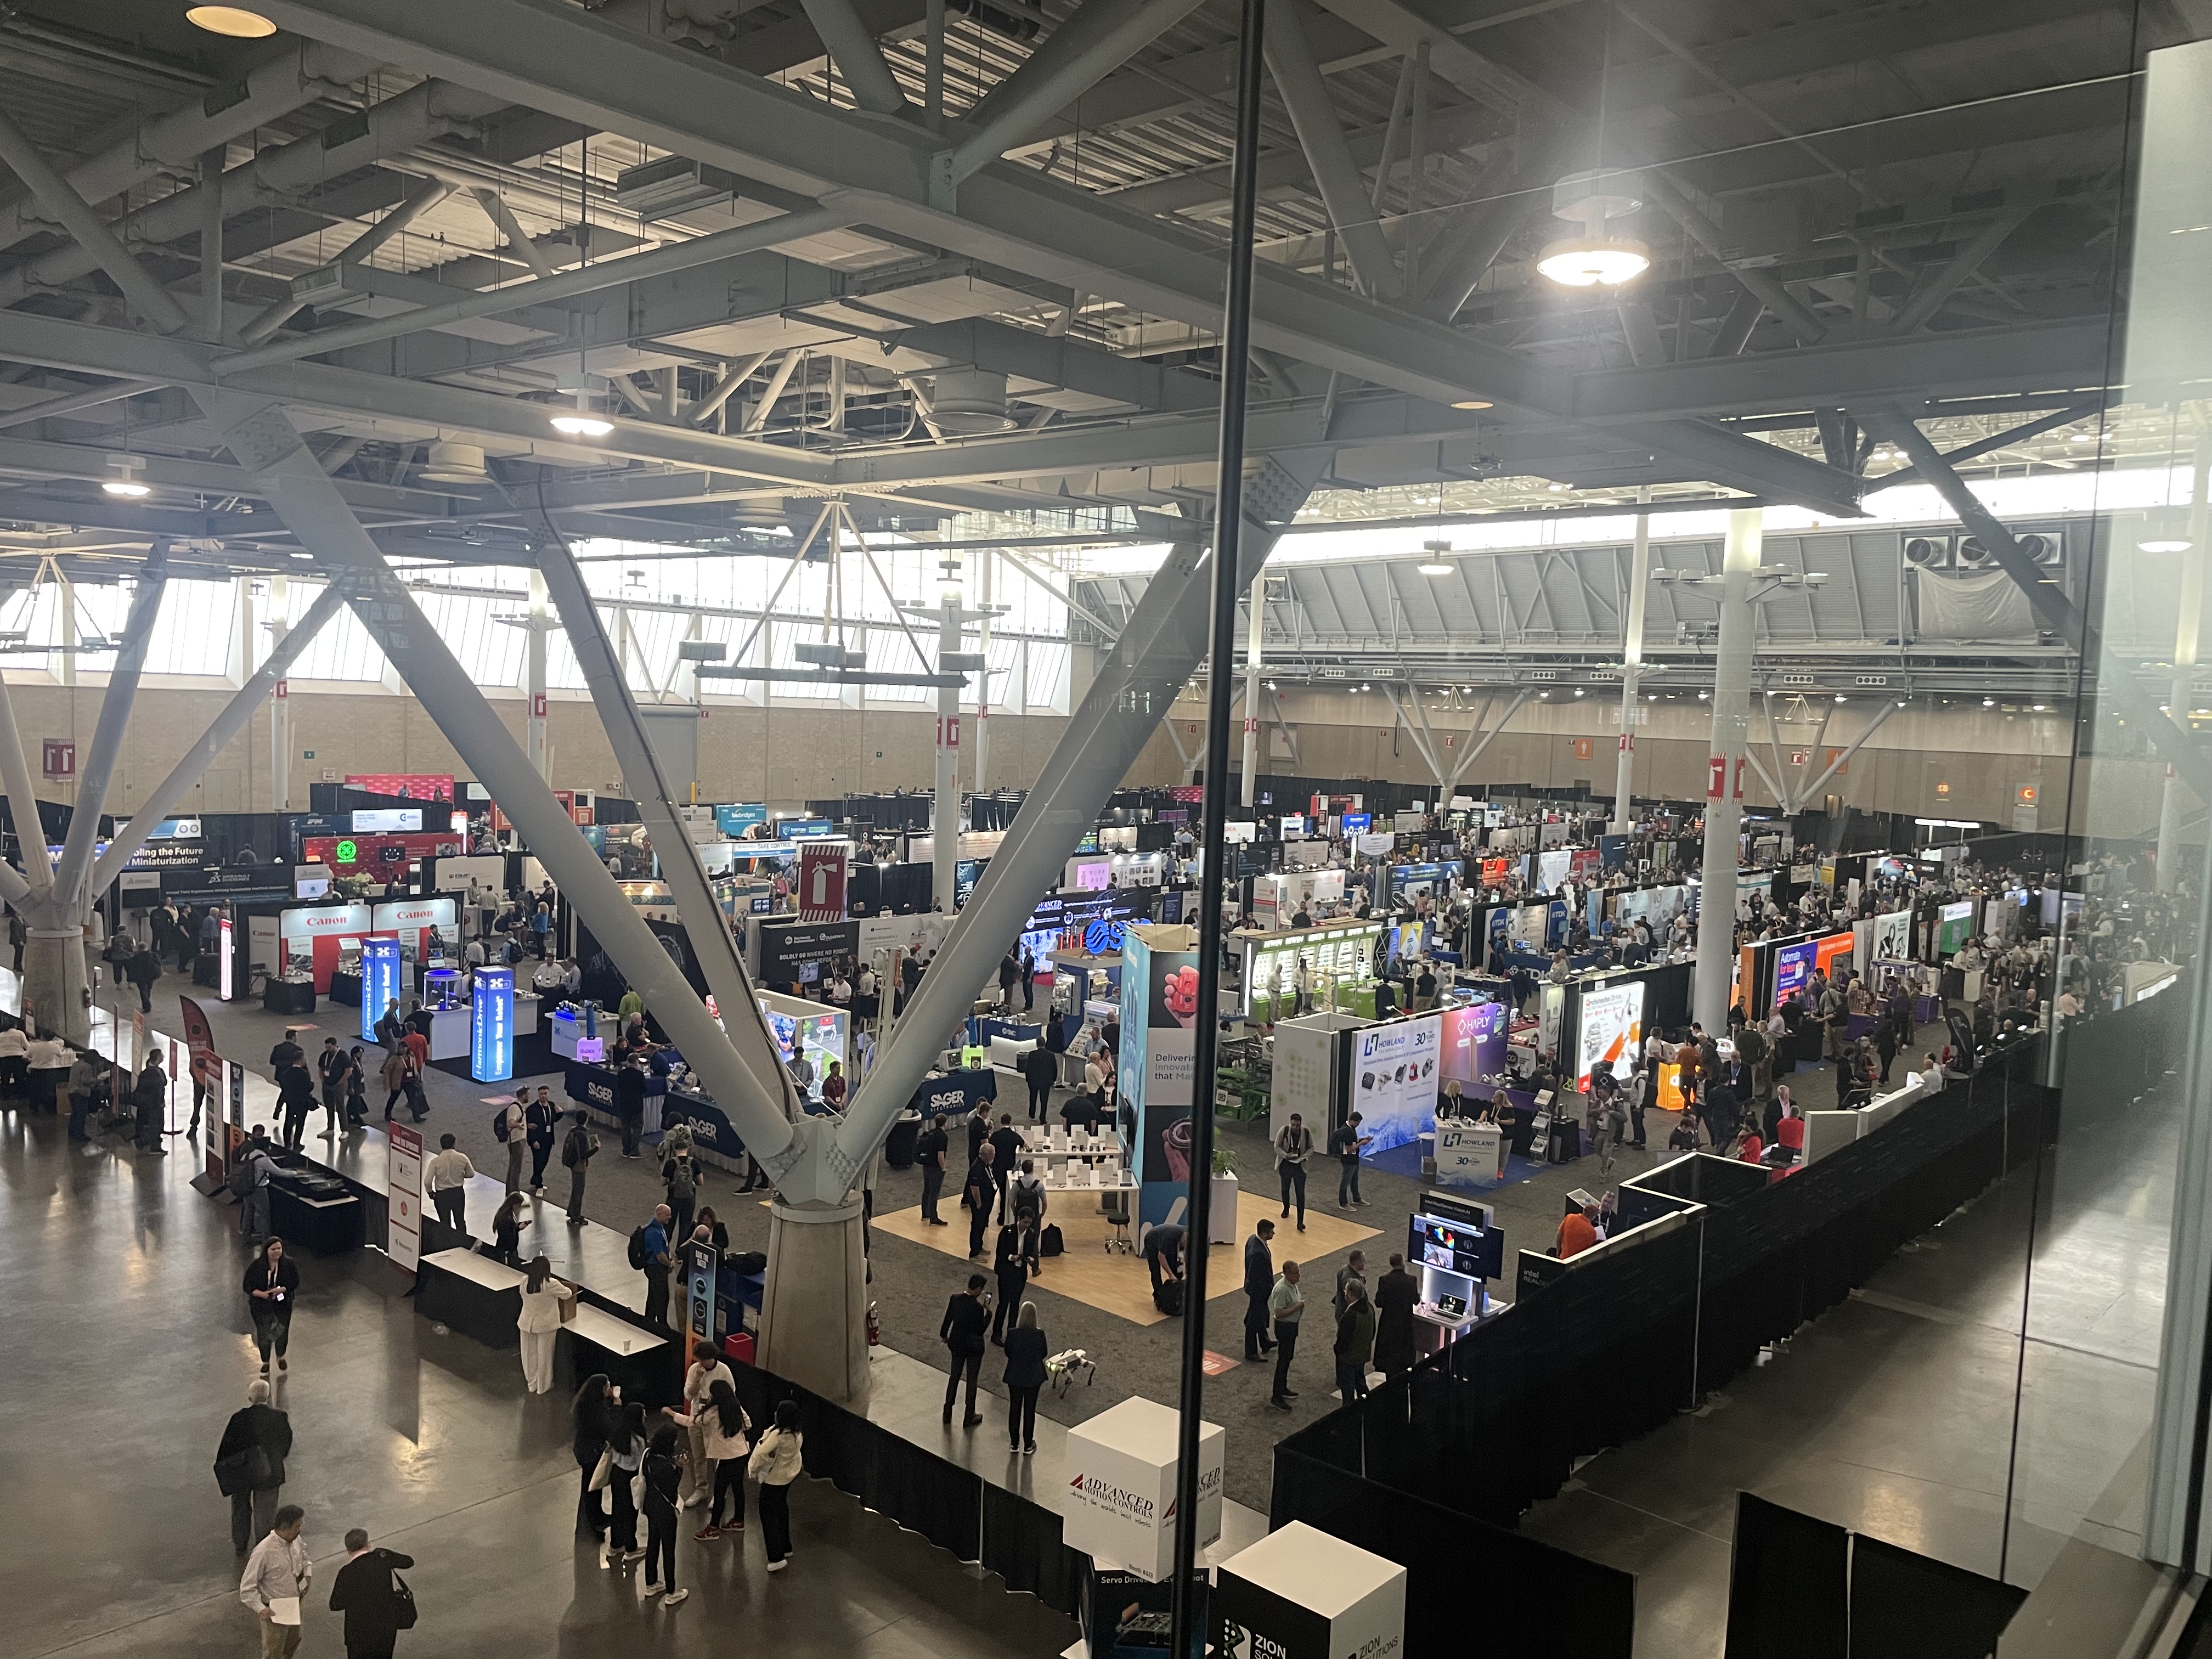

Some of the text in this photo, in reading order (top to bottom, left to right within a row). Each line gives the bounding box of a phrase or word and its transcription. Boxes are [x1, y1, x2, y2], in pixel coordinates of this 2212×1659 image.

[133, 847, 204, 858] bling the Future
[132, 857, 199, 866] Miniaturization
[307, 916, 347, 926] Canon
[397, 910, 433, 919] Canon
[1496, 918, 1506, 926] TDK
[1263, 939, 1283, 949] HIWIN
[1285, 935, 1304, 945] HIWIN
[1781, 951, 1801, 964] Automate
[495, 1022, 503, 1040] Your
[1468, 1016, 1490, 1031] HAPLY
[1379, 1036, 1405, 1048] HOWLAND
[1415, 1032, 1426, 1046] 30
[588, 1081, 613, 1103] SAGER
[930, 1090, 964, 1108] SAGER
[688, 1116, 717, 1137] SAGER
[1455, 1156, 1469, 1165] 30
[1523, 1268, 1539, 1279] intel
[1198, 1476, 1220, 1493] NTROLS
[1084, 1477, 1154, 1510] ADVANCED
[1084, 1485, 1153, 1520] MOTION CONTROLS
[1128, 1563, 1142, 1574] Booth
[1255, 1633, 1286, 1659] ZION
[1359, 1635, 1380, 1659] ZION
[1366, 1636, 1398, 1659] LUTIONS
